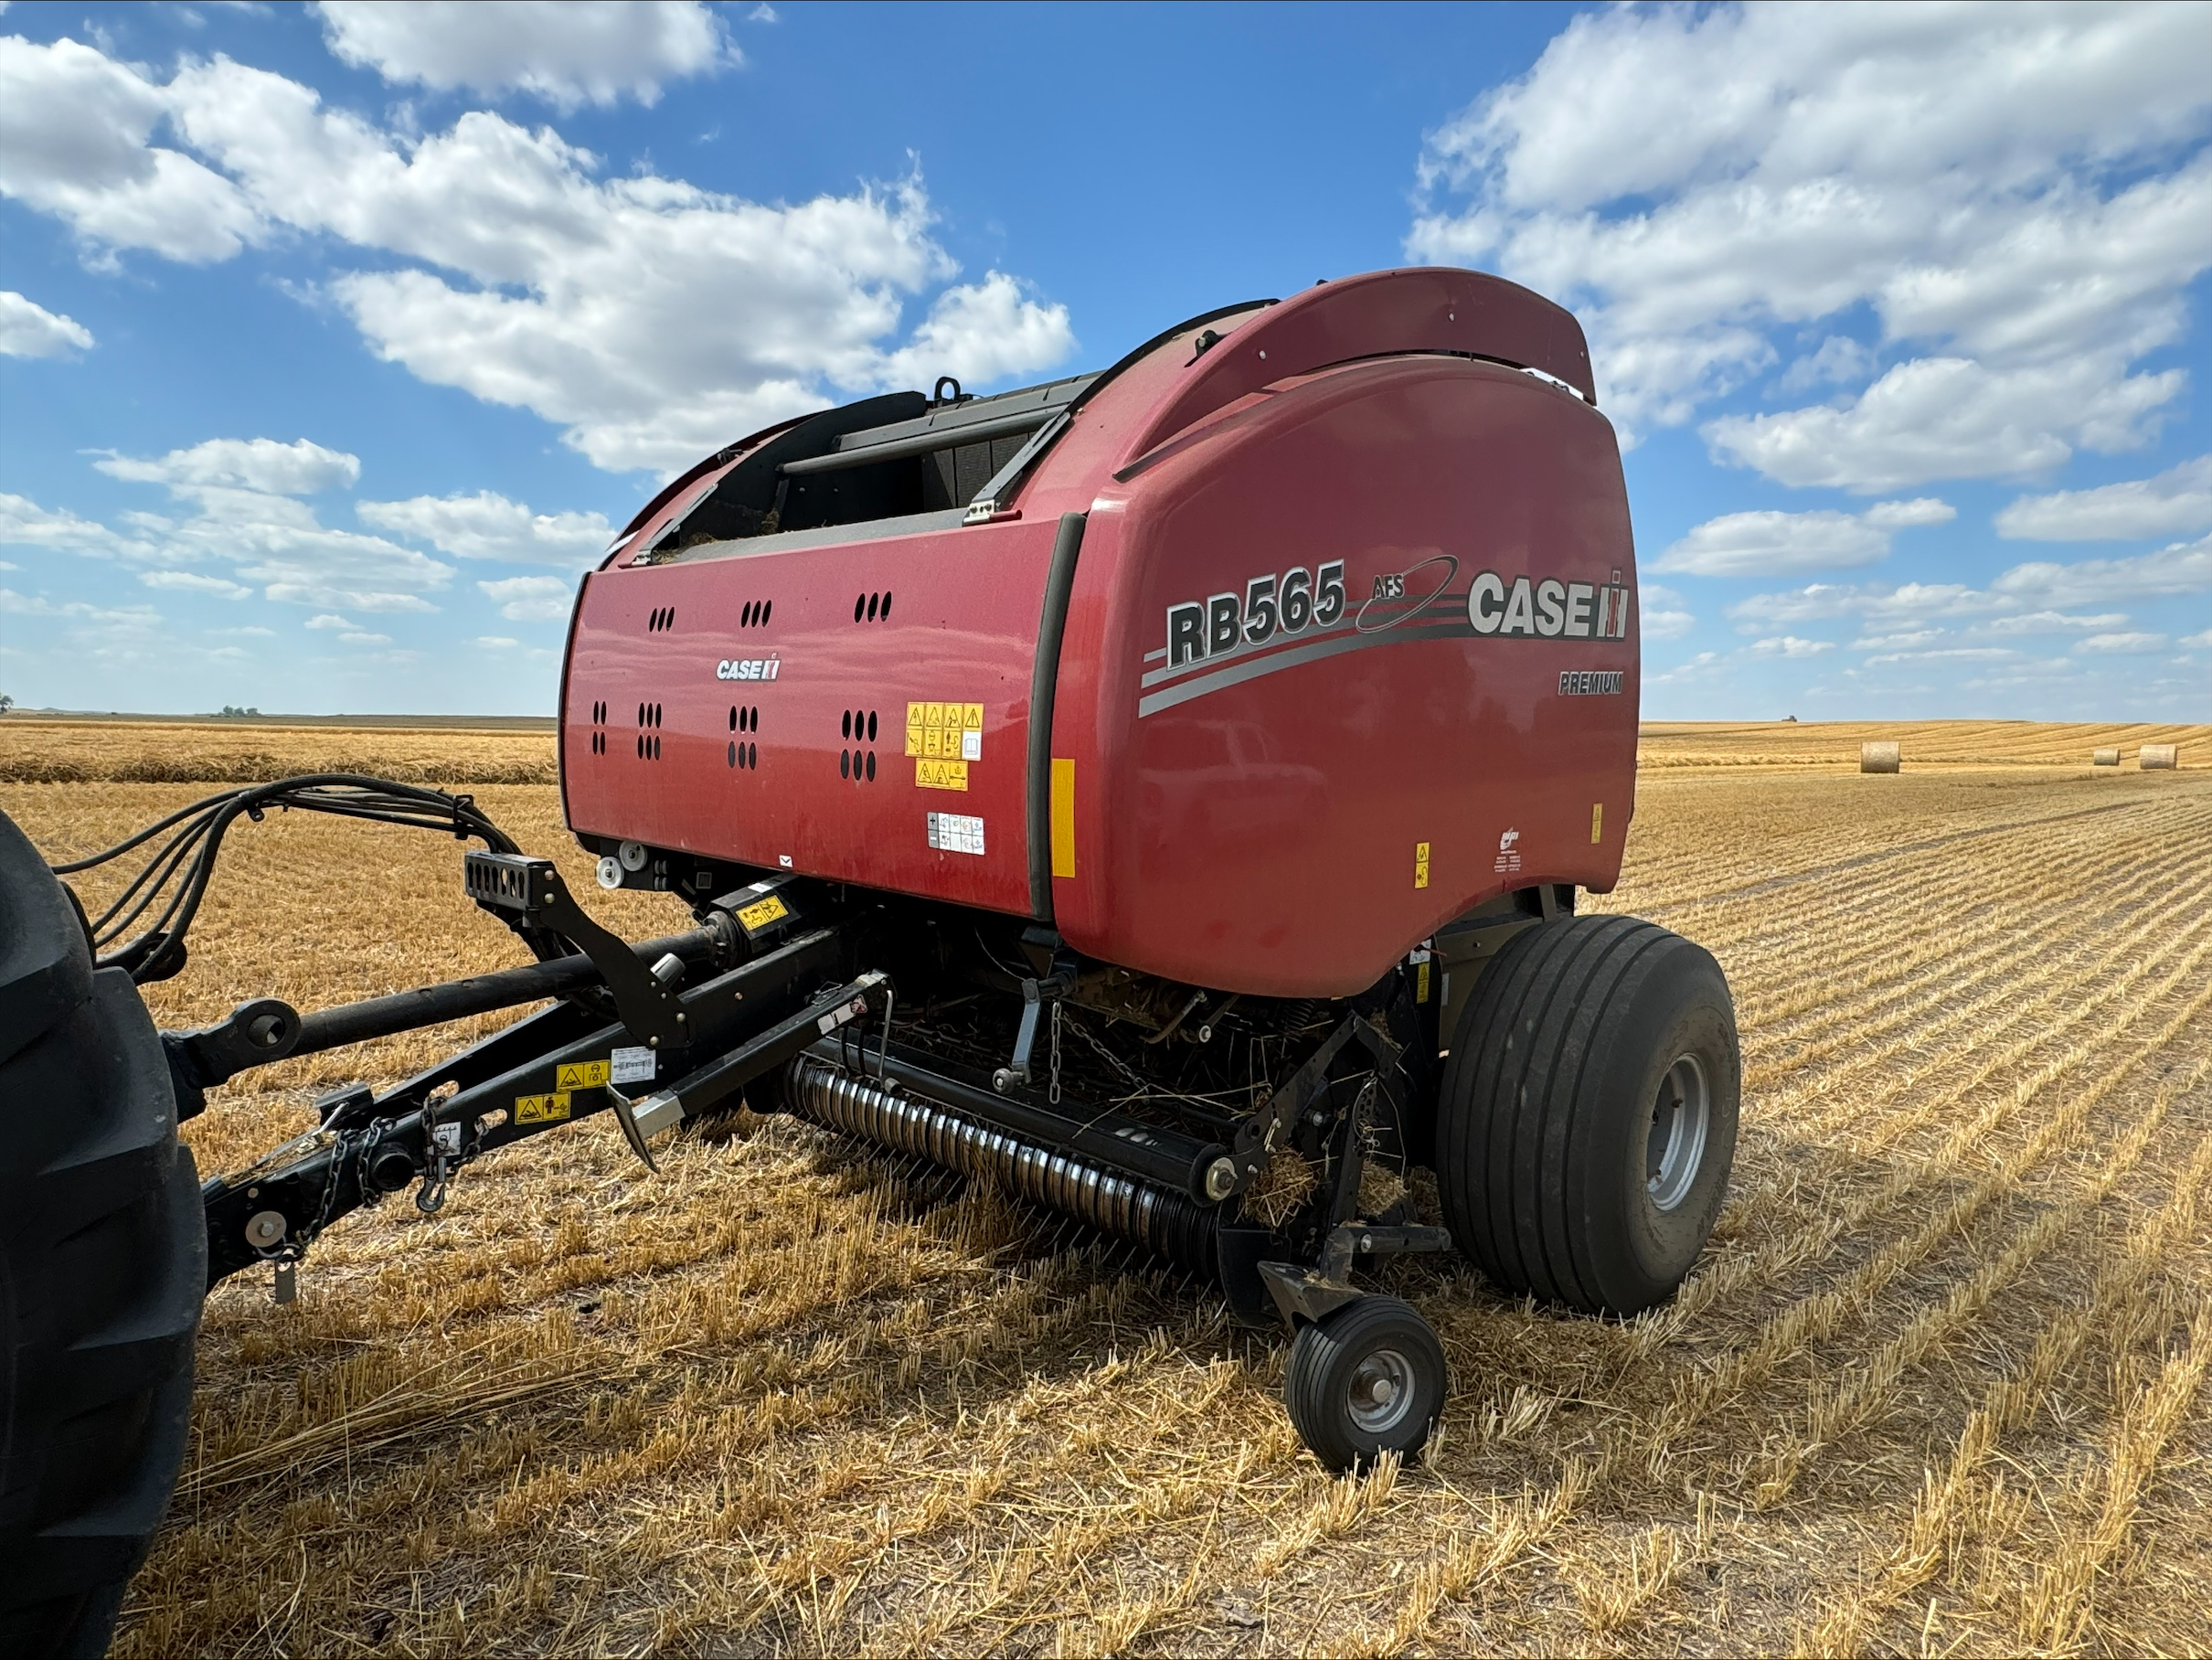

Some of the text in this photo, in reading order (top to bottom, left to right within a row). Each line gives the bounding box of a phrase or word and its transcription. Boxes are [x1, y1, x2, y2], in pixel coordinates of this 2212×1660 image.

[1371, 573, 1405, 601] AFS
[1167, 559, 1345, 671] RB565
[1468, 572, 1593, 636] CASE
[717, 659, 763, 679] CASE
[1558, 671, 1624, 696] PREMIUM
